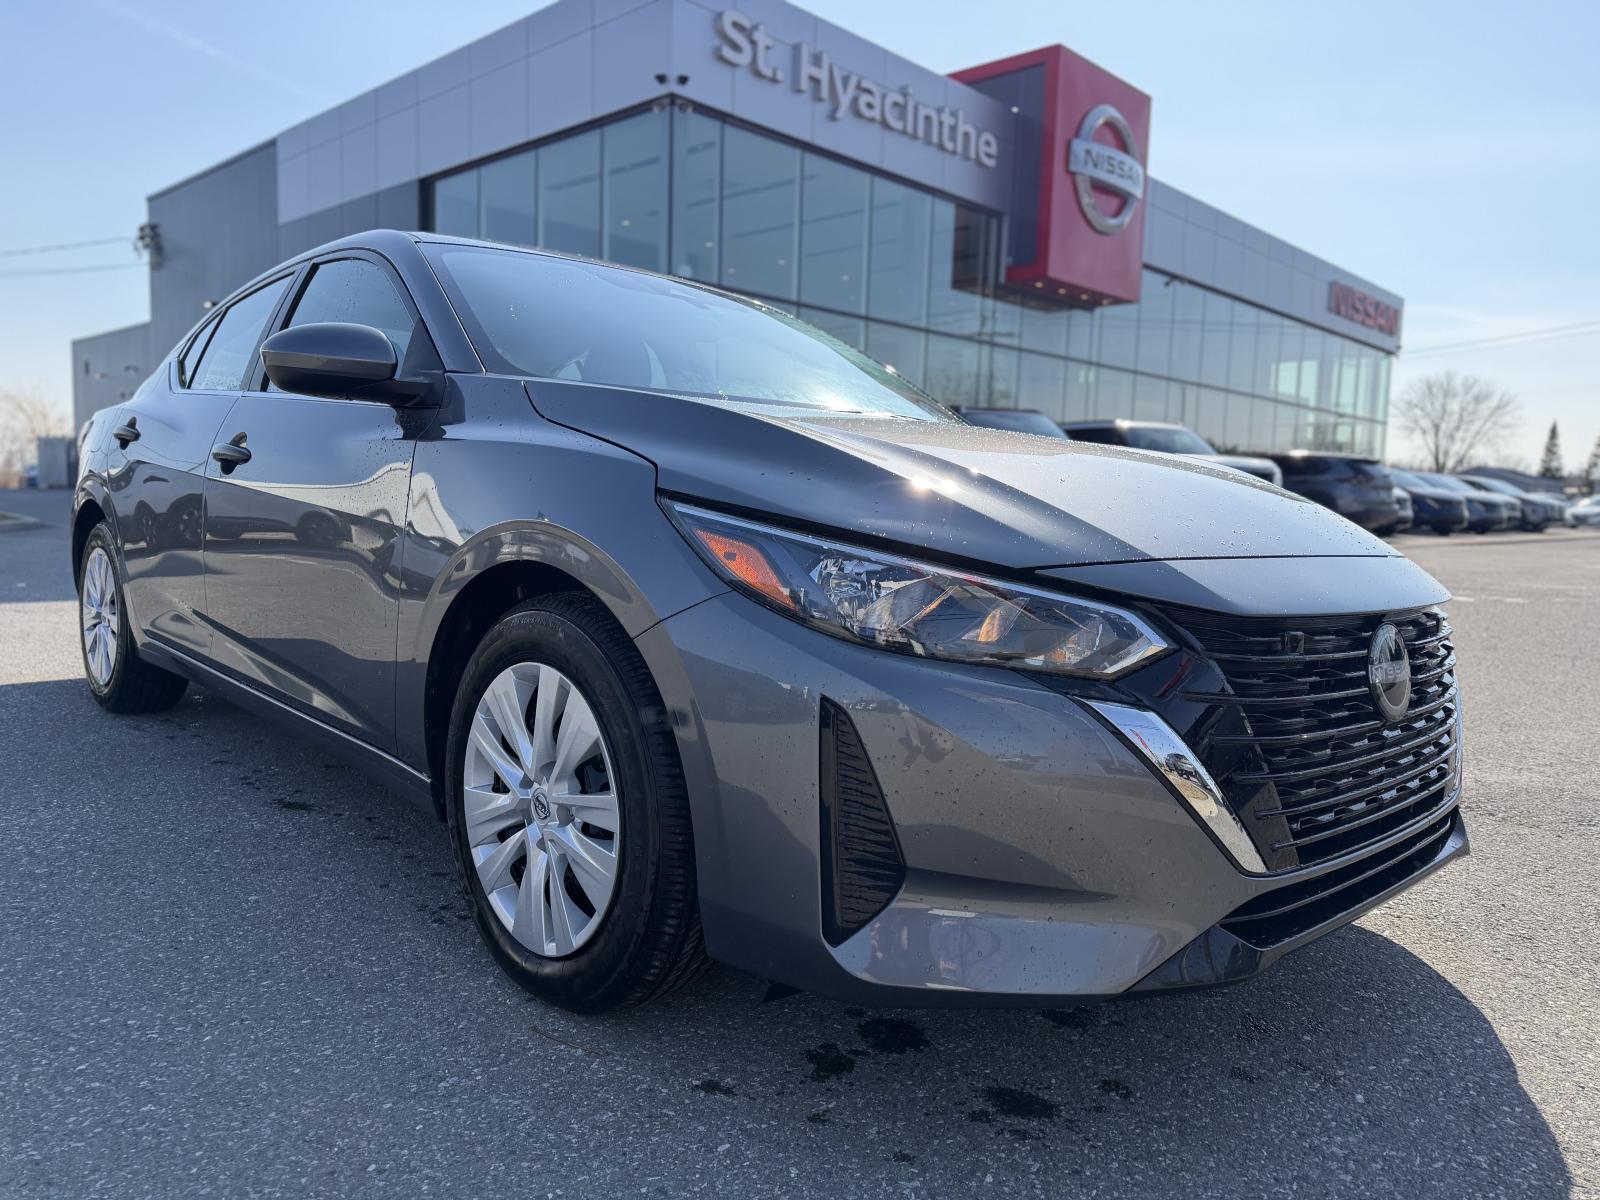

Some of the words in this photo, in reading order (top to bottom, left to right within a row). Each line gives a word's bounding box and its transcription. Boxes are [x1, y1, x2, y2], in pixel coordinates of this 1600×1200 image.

[715, 9, 784, 83] St.
[799, 41, 998, 168] Hyacinthe
[1328, 281, 1398, 336] NISSAN
